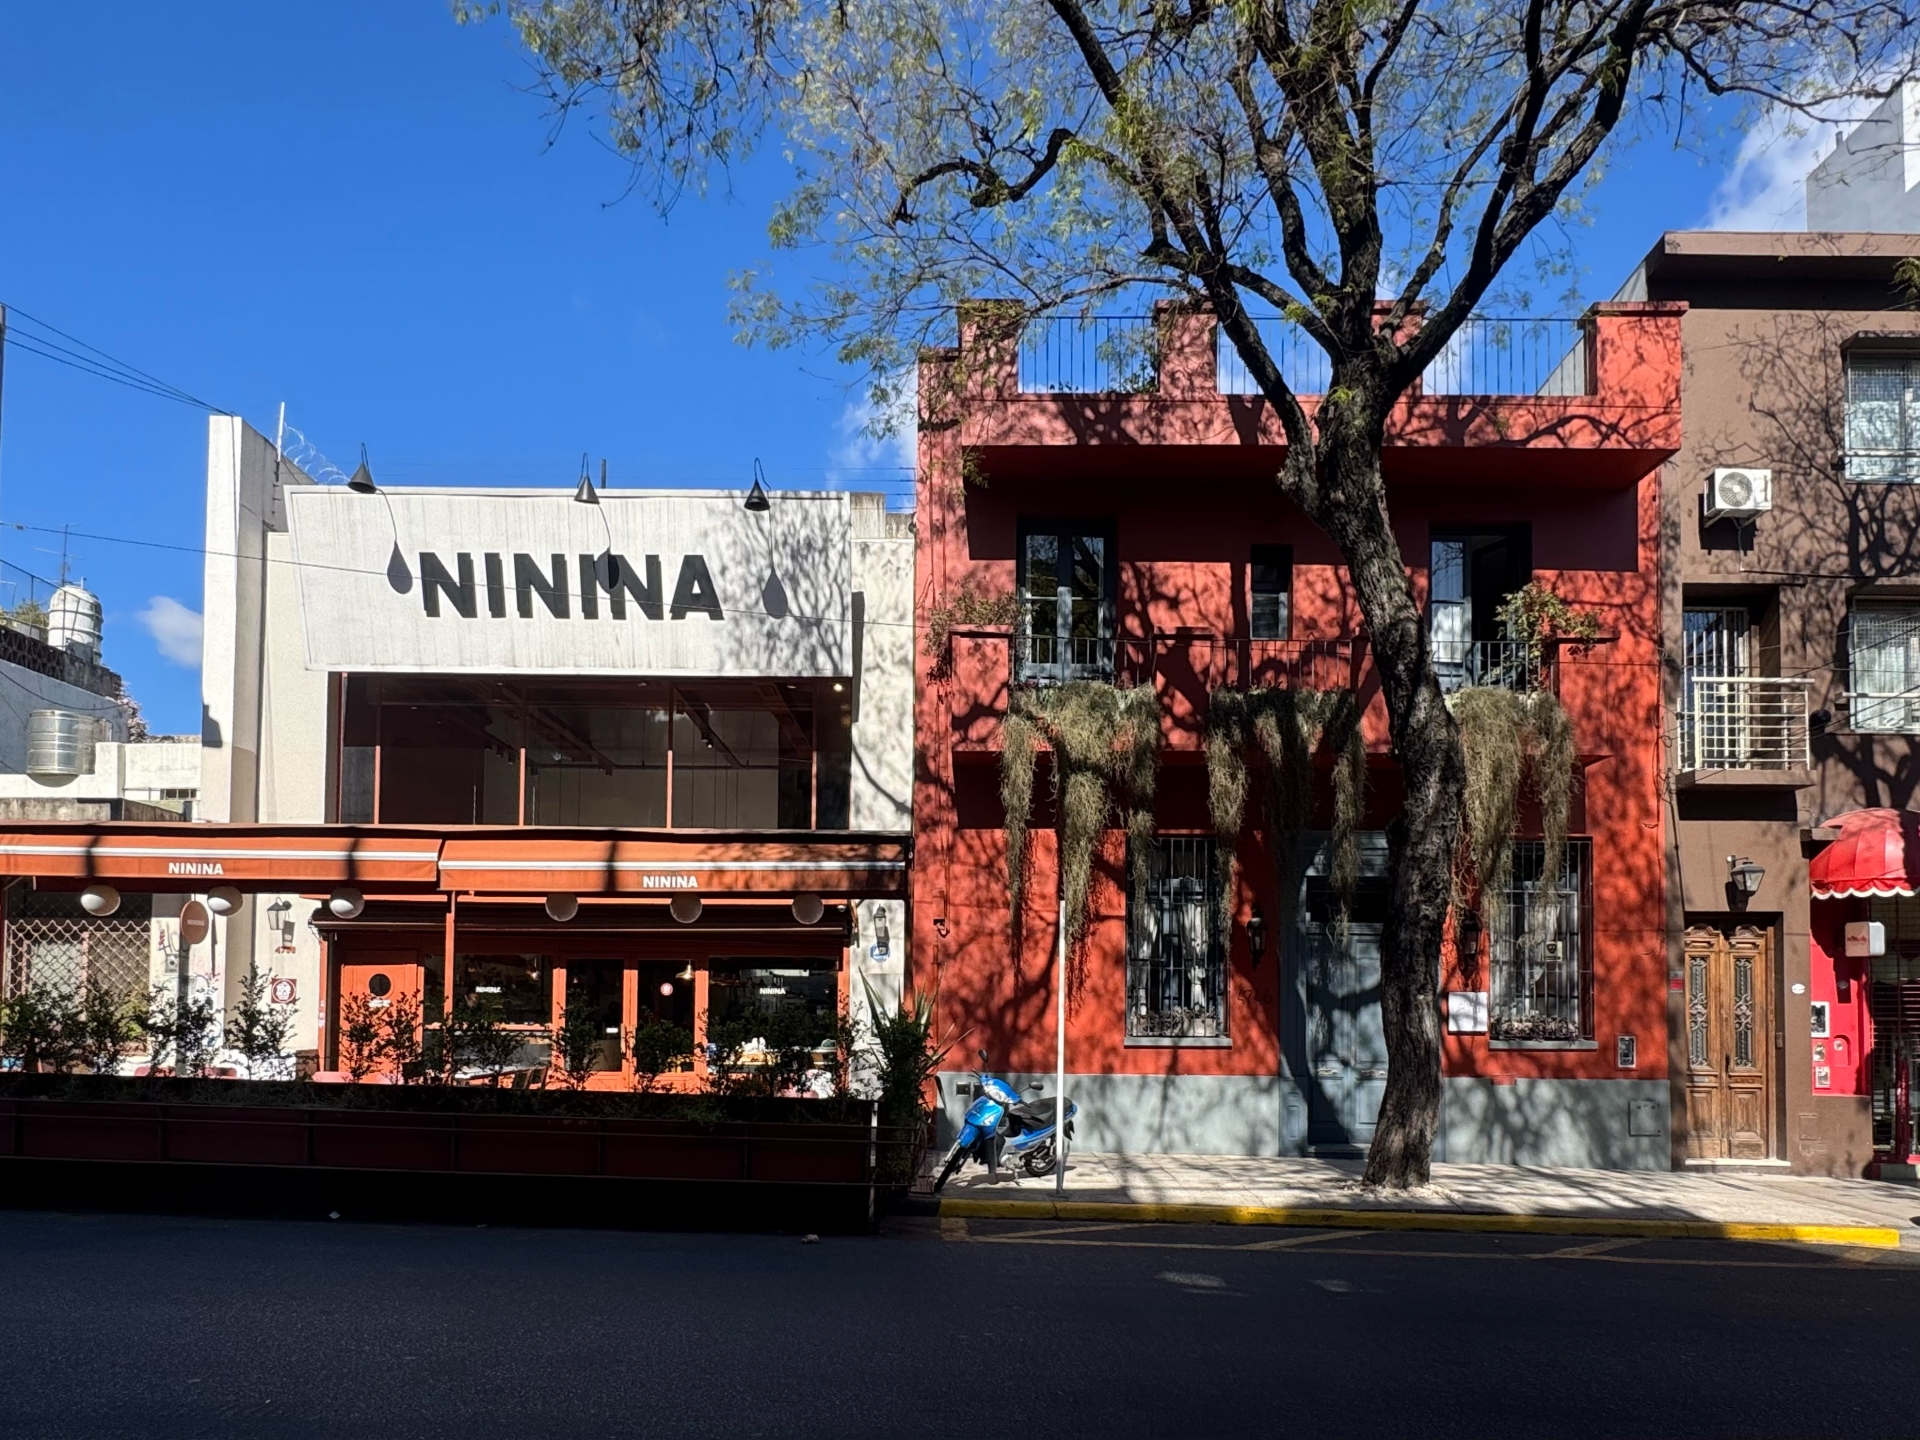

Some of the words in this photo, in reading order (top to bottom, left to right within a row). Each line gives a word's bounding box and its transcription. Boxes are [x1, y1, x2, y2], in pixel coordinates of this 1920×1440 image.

[419, 552, 725, 621] NININA
[168, 862, 224, 875] NININA
[643, 875, 699, 888] NININA
